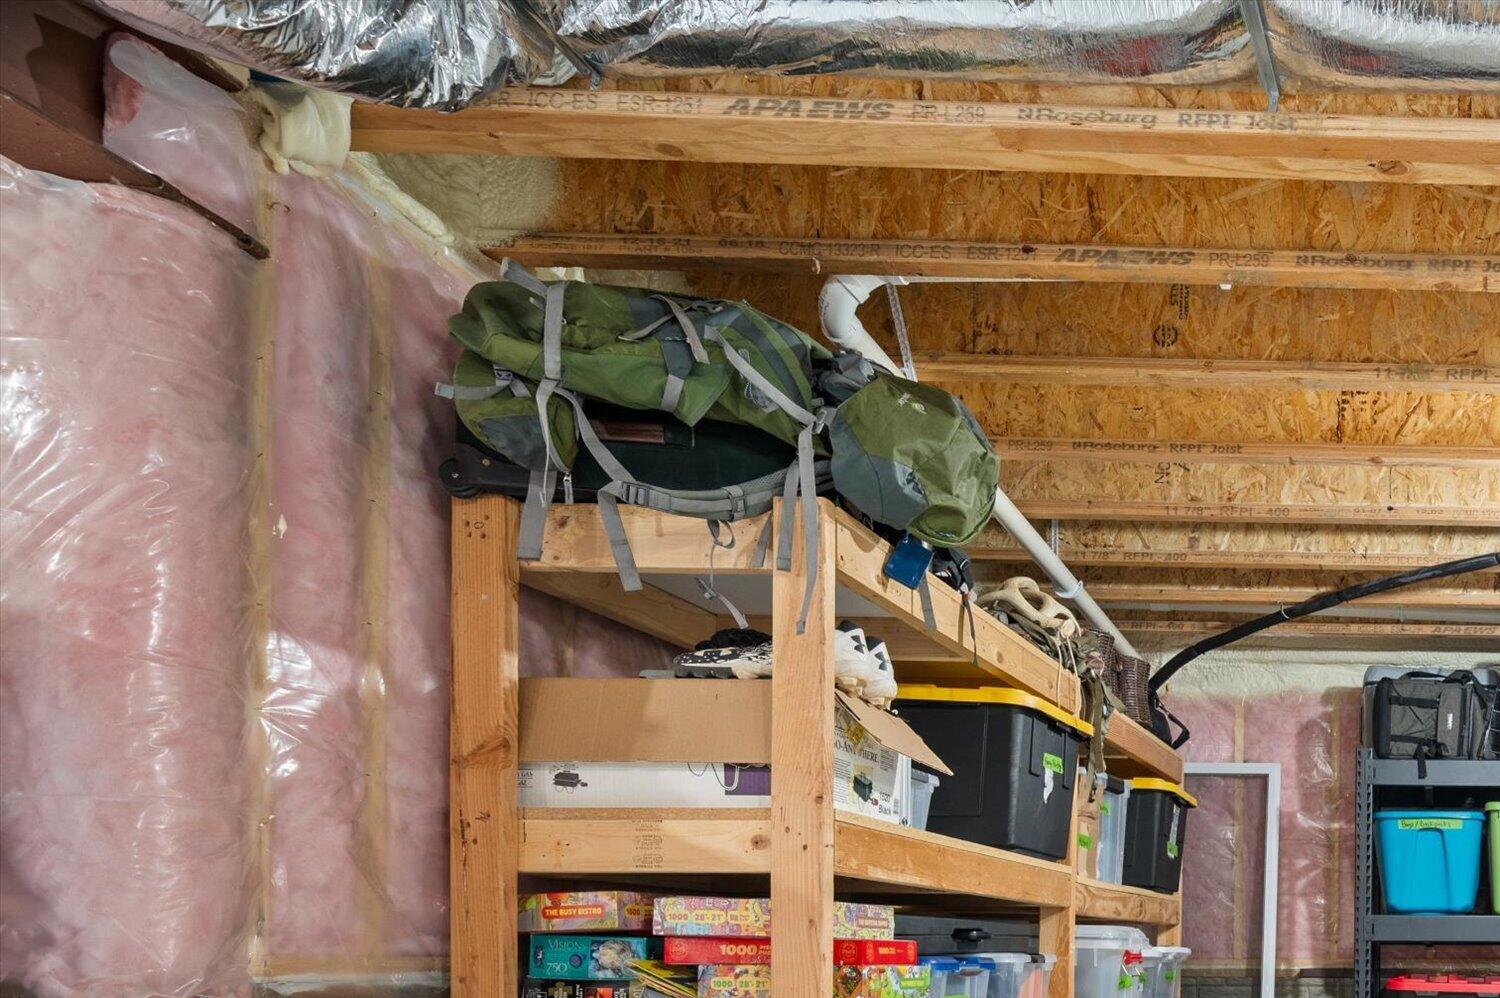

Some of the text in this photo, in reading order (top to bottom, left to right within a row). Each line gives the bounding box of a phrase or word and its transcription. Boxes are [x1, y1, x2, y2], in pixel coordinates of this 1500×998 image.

[528, 92, 598, 109] ICC-ES
[616, 95, 702, 114] ESR-1251
[723, 98, 801, 117] APA
[806, 99, 896, 120] EWS
[912, 104, 985, 123] PR-L259
[1036, 107, 1157, 130] Roseburg
[779, 241, 822, 256] CCMC
[895, 244, 951, 259] ICC-ES
[1054, 248, 1120, 263] APA
[1122, 249, 1196, 266] EWS
[1209, 252, 1270, 267] PR-L259
[1310, 254, 1415, 272] Roseburg
[1446, 367, 1489, 381] RFPI
[1008, 440, 1244, 455] PR-L259 Roseburg RFPI Joist
[1219, 506, 1252, 517] RFPI
[1267, 507, 1290, 517] 400
[1123, 552, 1153, 561] RFPI
[1164, 552, 1188, 561] 400
[878, 804, 893, 817] Black
[546, 906, 602, 916] THE BUSY BISTRO
[720, 944, 758, 956] 1000
[546, 962, 567, 974] 750
[713, 980, 733, 988] 1000
